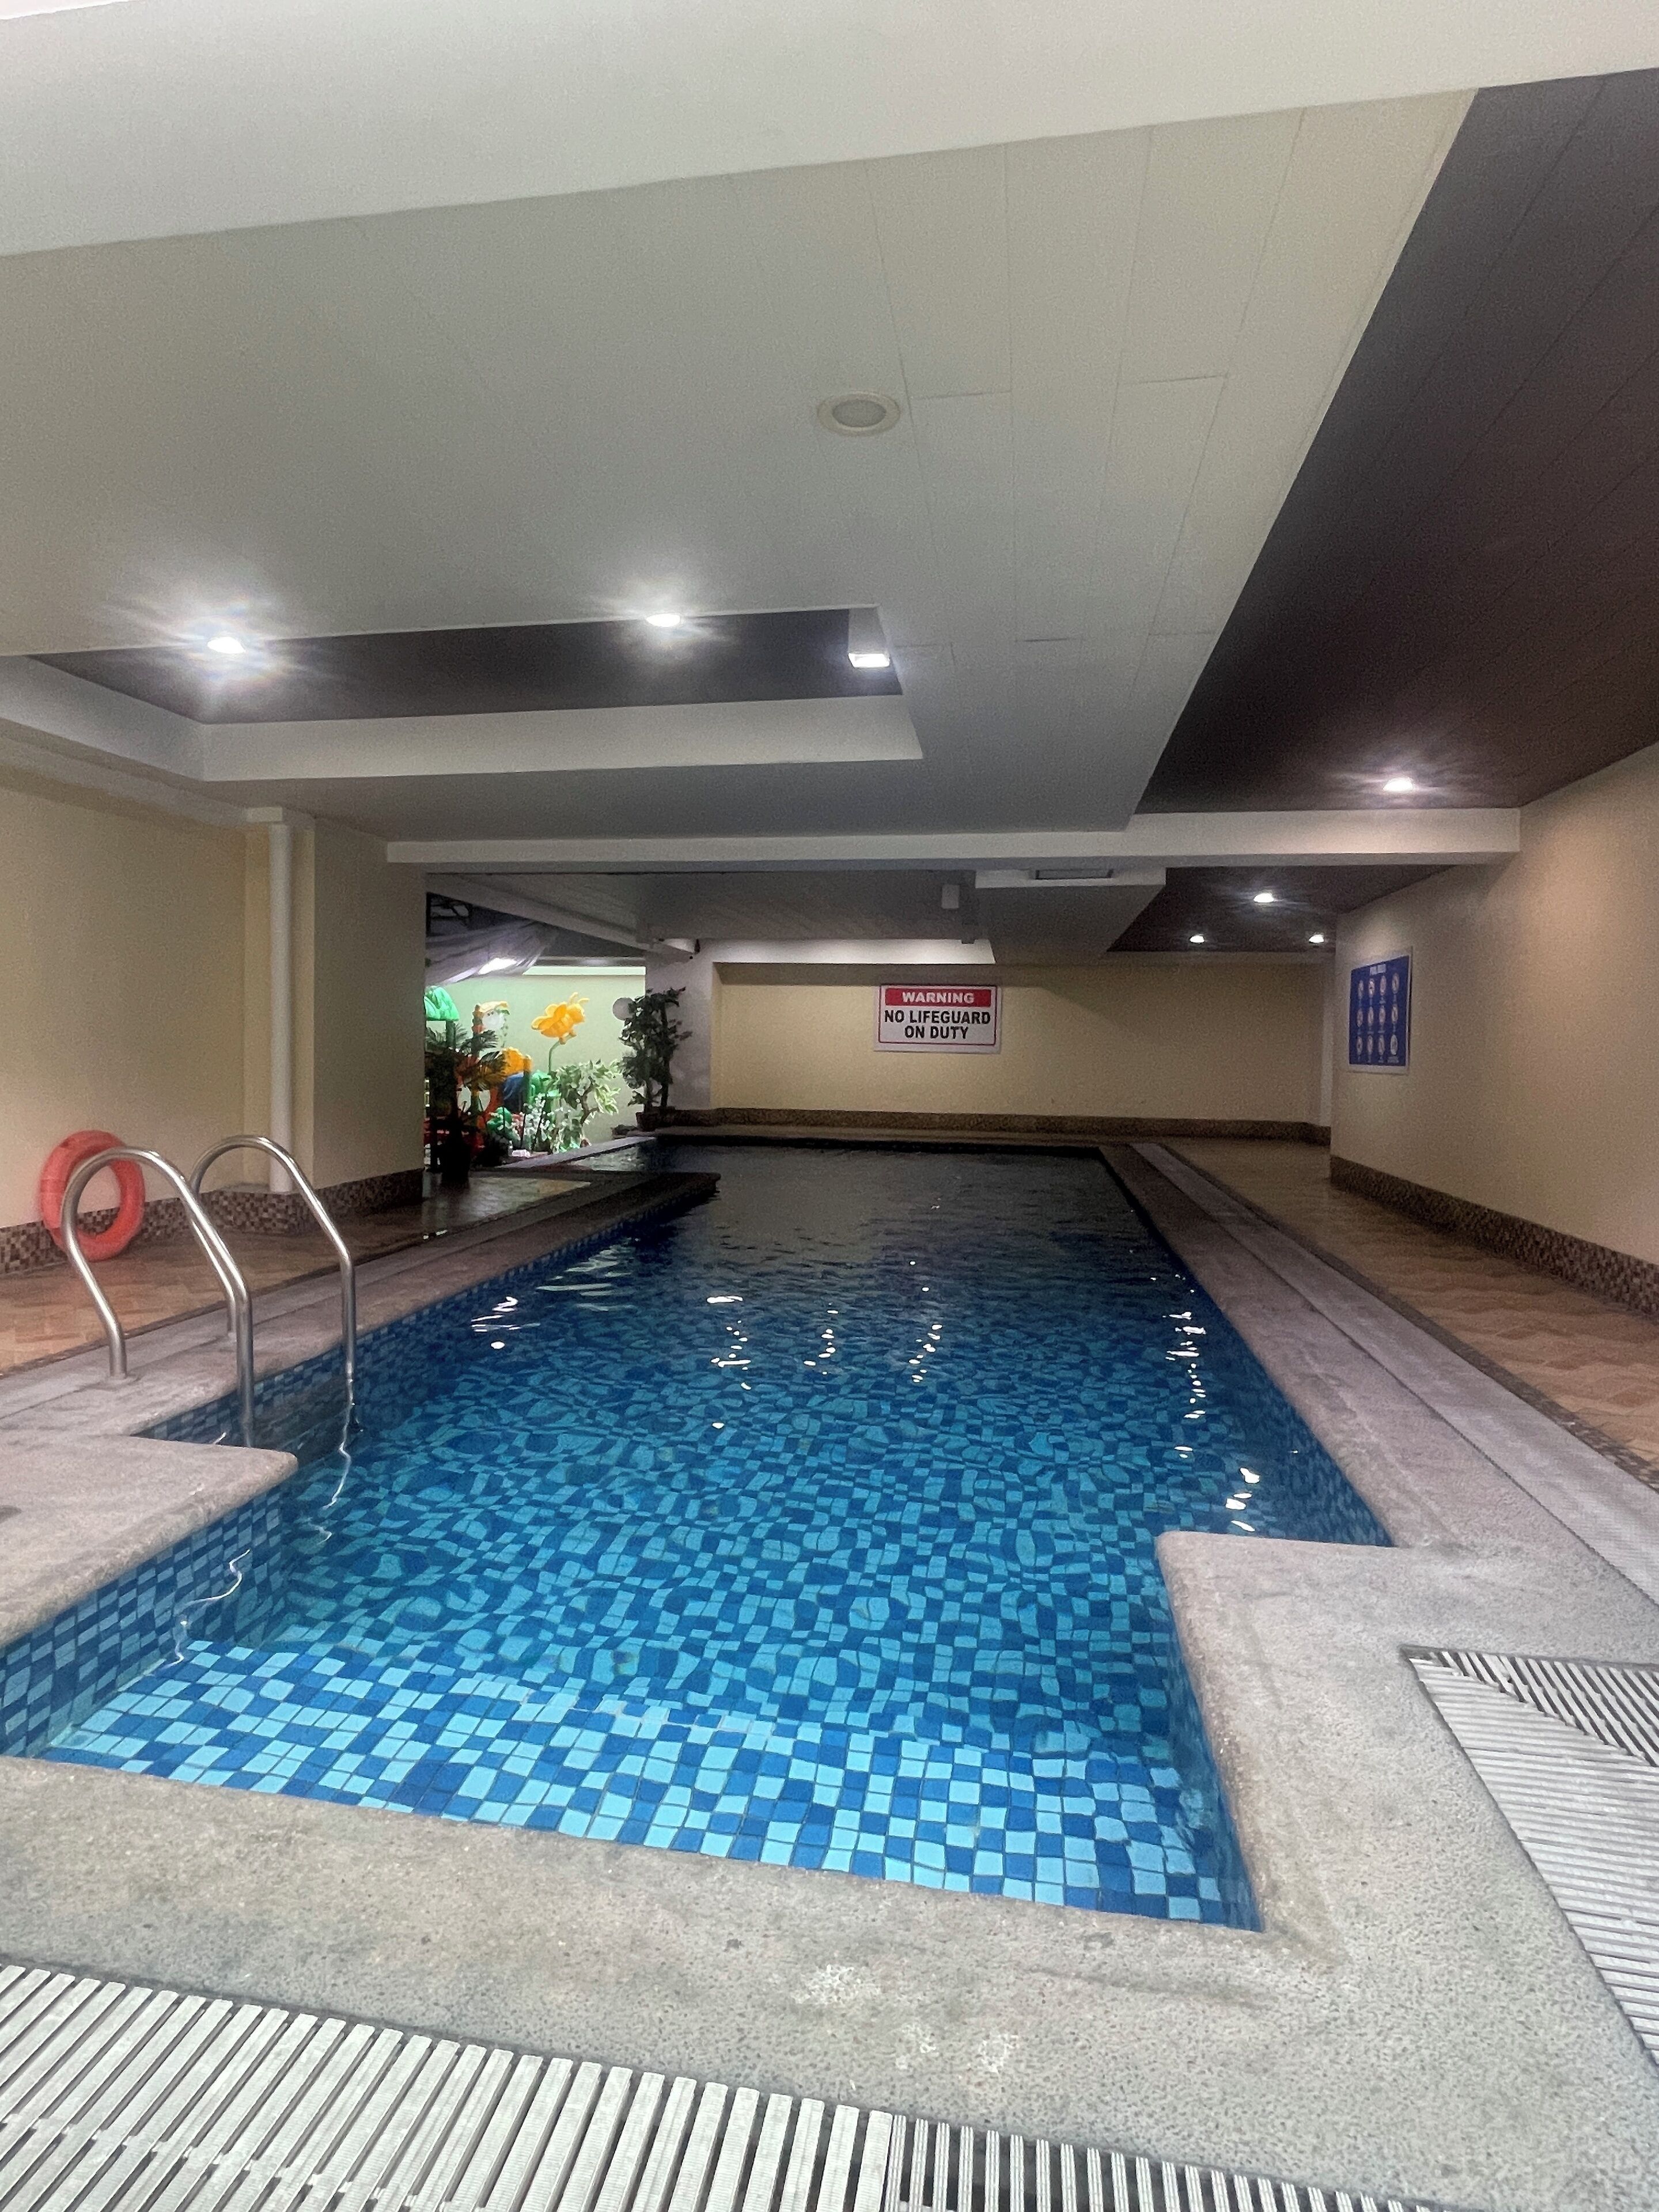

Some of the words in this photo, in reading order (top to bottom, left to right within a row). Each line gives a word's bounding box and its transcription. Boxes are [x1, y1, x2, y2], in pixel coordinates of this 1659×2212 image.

[902, 992, 975, 1003] WARNING
[884, 1010, 904, 1022] NO
[910, 1010, 991, 1024] LIFEGUARD
[904, 1025, 925, 1039] ON
[930, 1026, 968, 1039] DUTY
